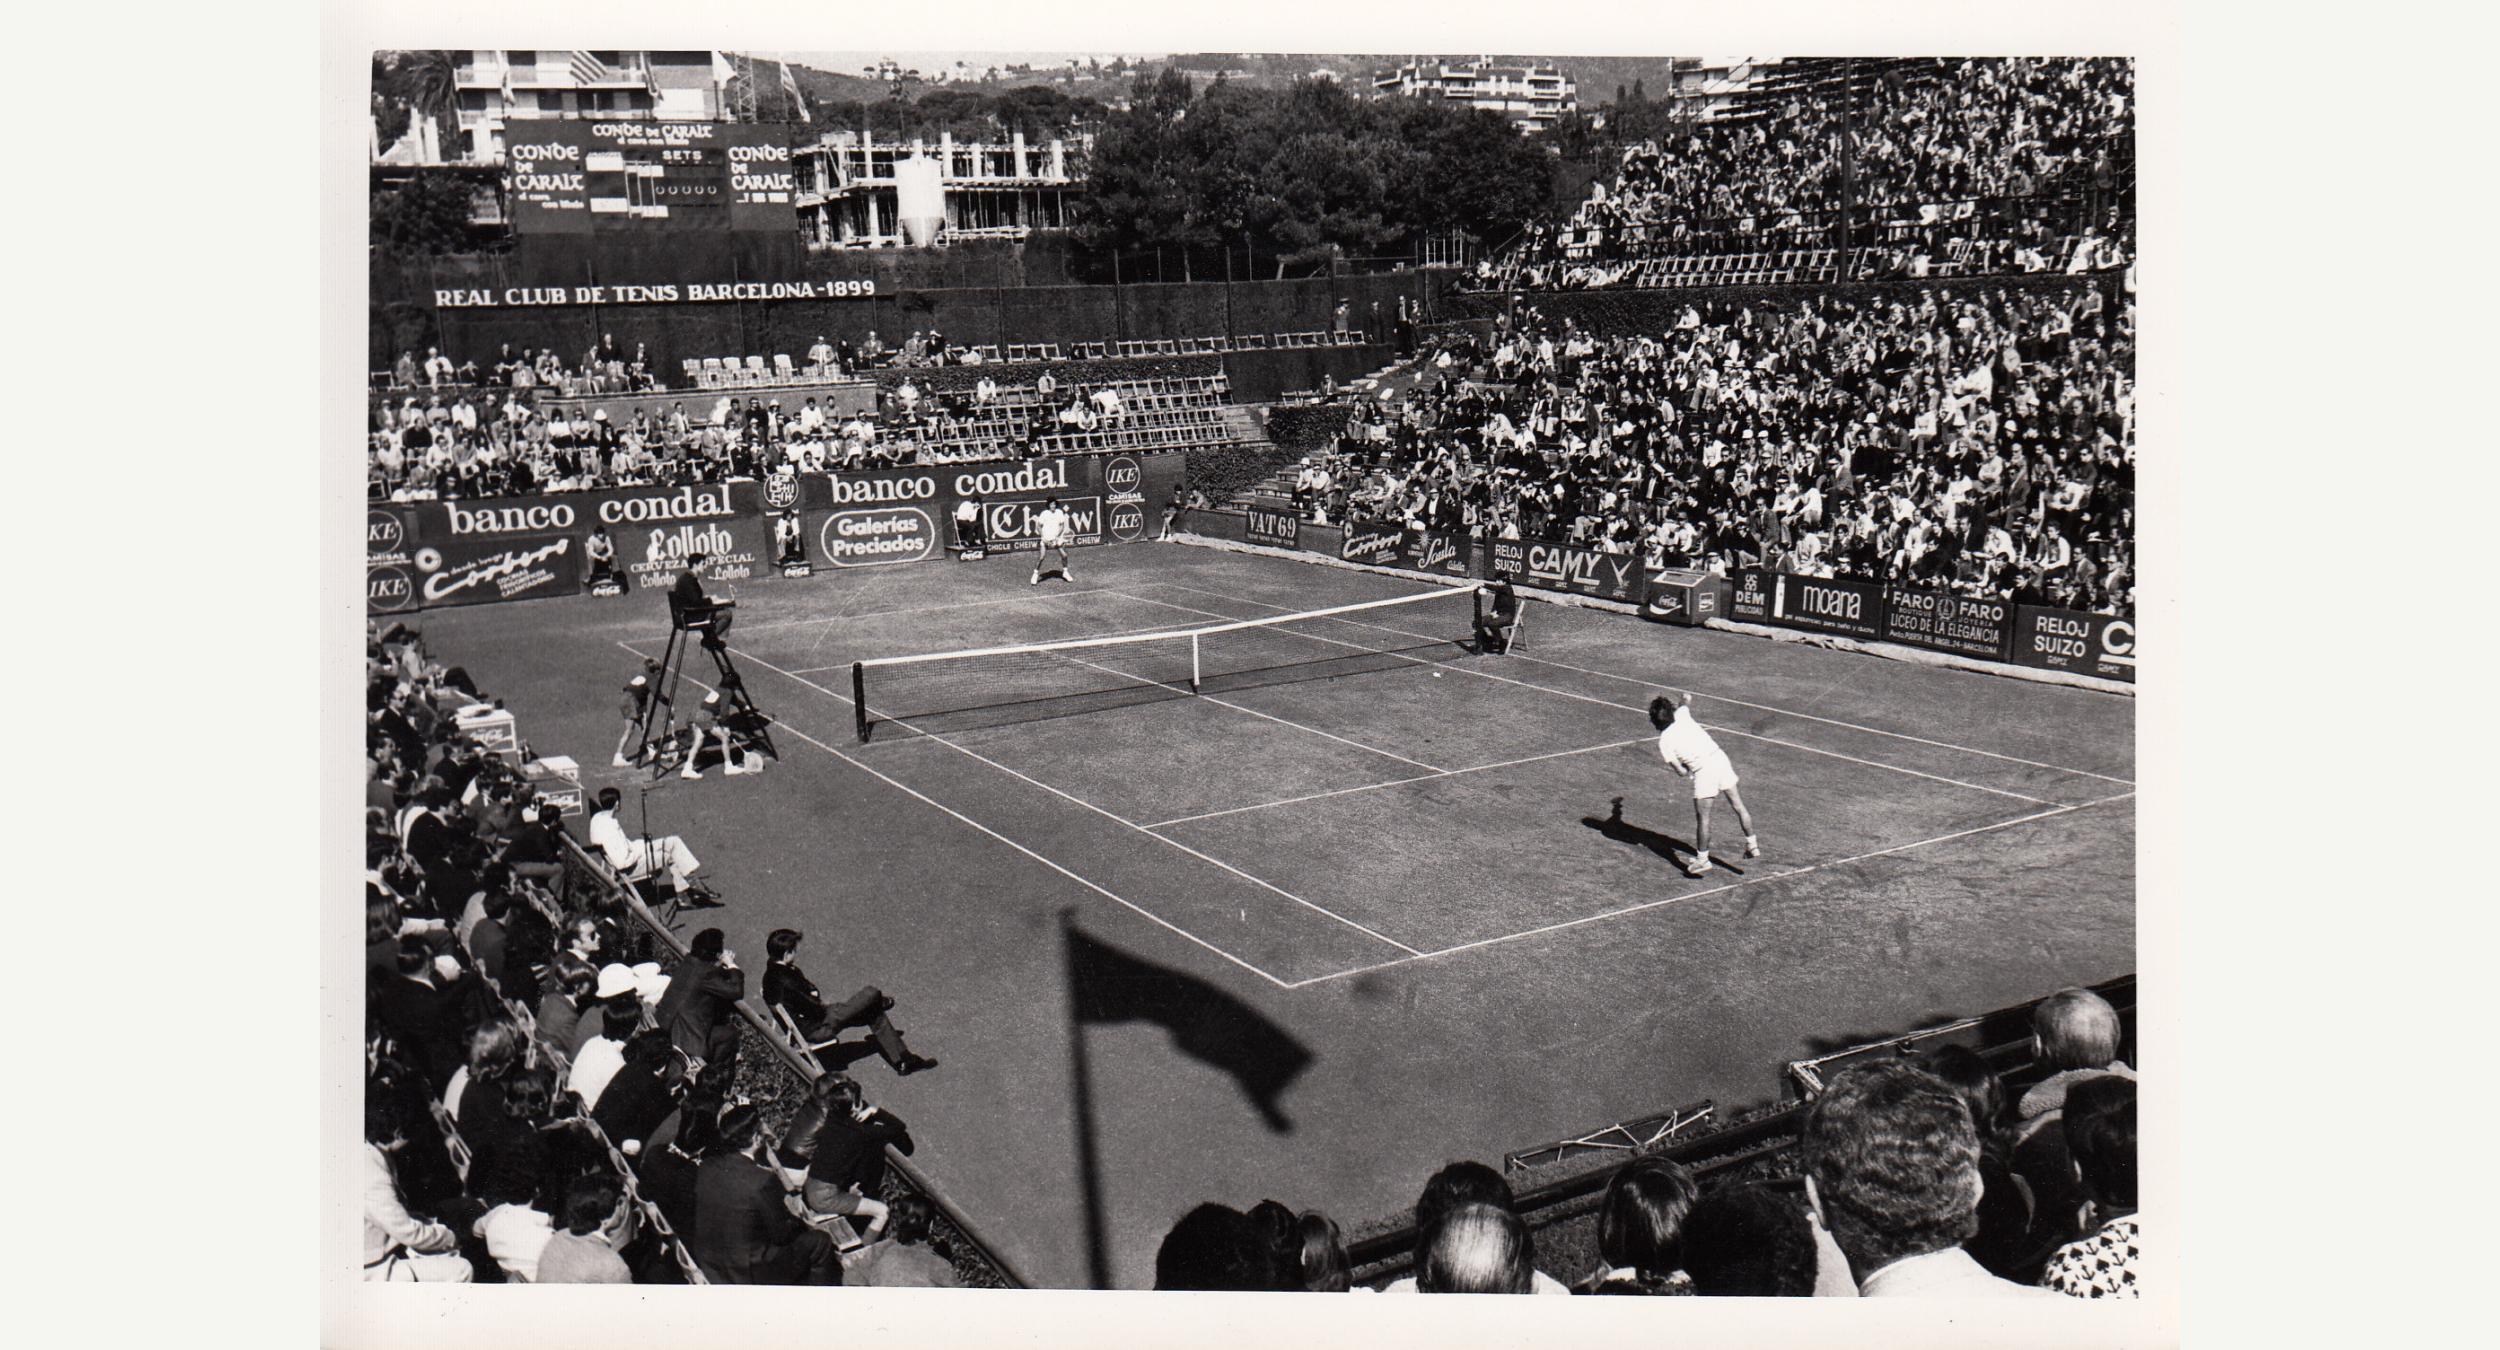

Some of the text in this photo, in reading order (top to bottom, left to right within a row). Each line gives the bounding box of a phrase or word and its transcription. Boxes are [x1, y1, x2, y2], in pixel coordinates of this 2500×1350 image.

[512, 142, 580, 160] CONDE
[662, 150, 702, 160] SETS
[728, 144, 789, 161] CONDE
[435, 289, 498, 307] REAL
[505, 287, 567, 306] CLUB
[575, 286, 606, 304] DE
[612, 284, 679, 302] TENIS
[827, 474, 936, 504] banco
[955, 459, 1069, 496] condal
[1108, 467, 1140, 484] IKE
[443, 502, 575, 534] banco
[599, 484, 735, 523] condal
[837, 516, 919, 537] Galerías
[1113, 512, 1143, 529] IKE
[1248, 511, 1276, 534] VAT
[1277, 516, 1296, 539] 69
[368, 521, 398, 541] KE
[832, 535, 925, 558] Preciados
[1495, 543, 1523, 560] RELOJ
[630, 552, 755, 573] CERVEZA SPECIAL
[1494, 558, 1522, 574] SUIZO
[1529, 545, 1602, 584] CAMY
[369, 578, 409, 598] IKE
[1736, 591, 1765, 605] DEM
[1803, 585, 1861, 620] moana
[1892, 591, 1934, 610] FARO
[1959, 601, 2003, 621] FARO
[1890, 613, 2000, 643] LICEO DE LA ELEGANCIA
[2035, 616, 2090, 638] RELOJ
[2034, 635, 2086, 657] SUIZO
